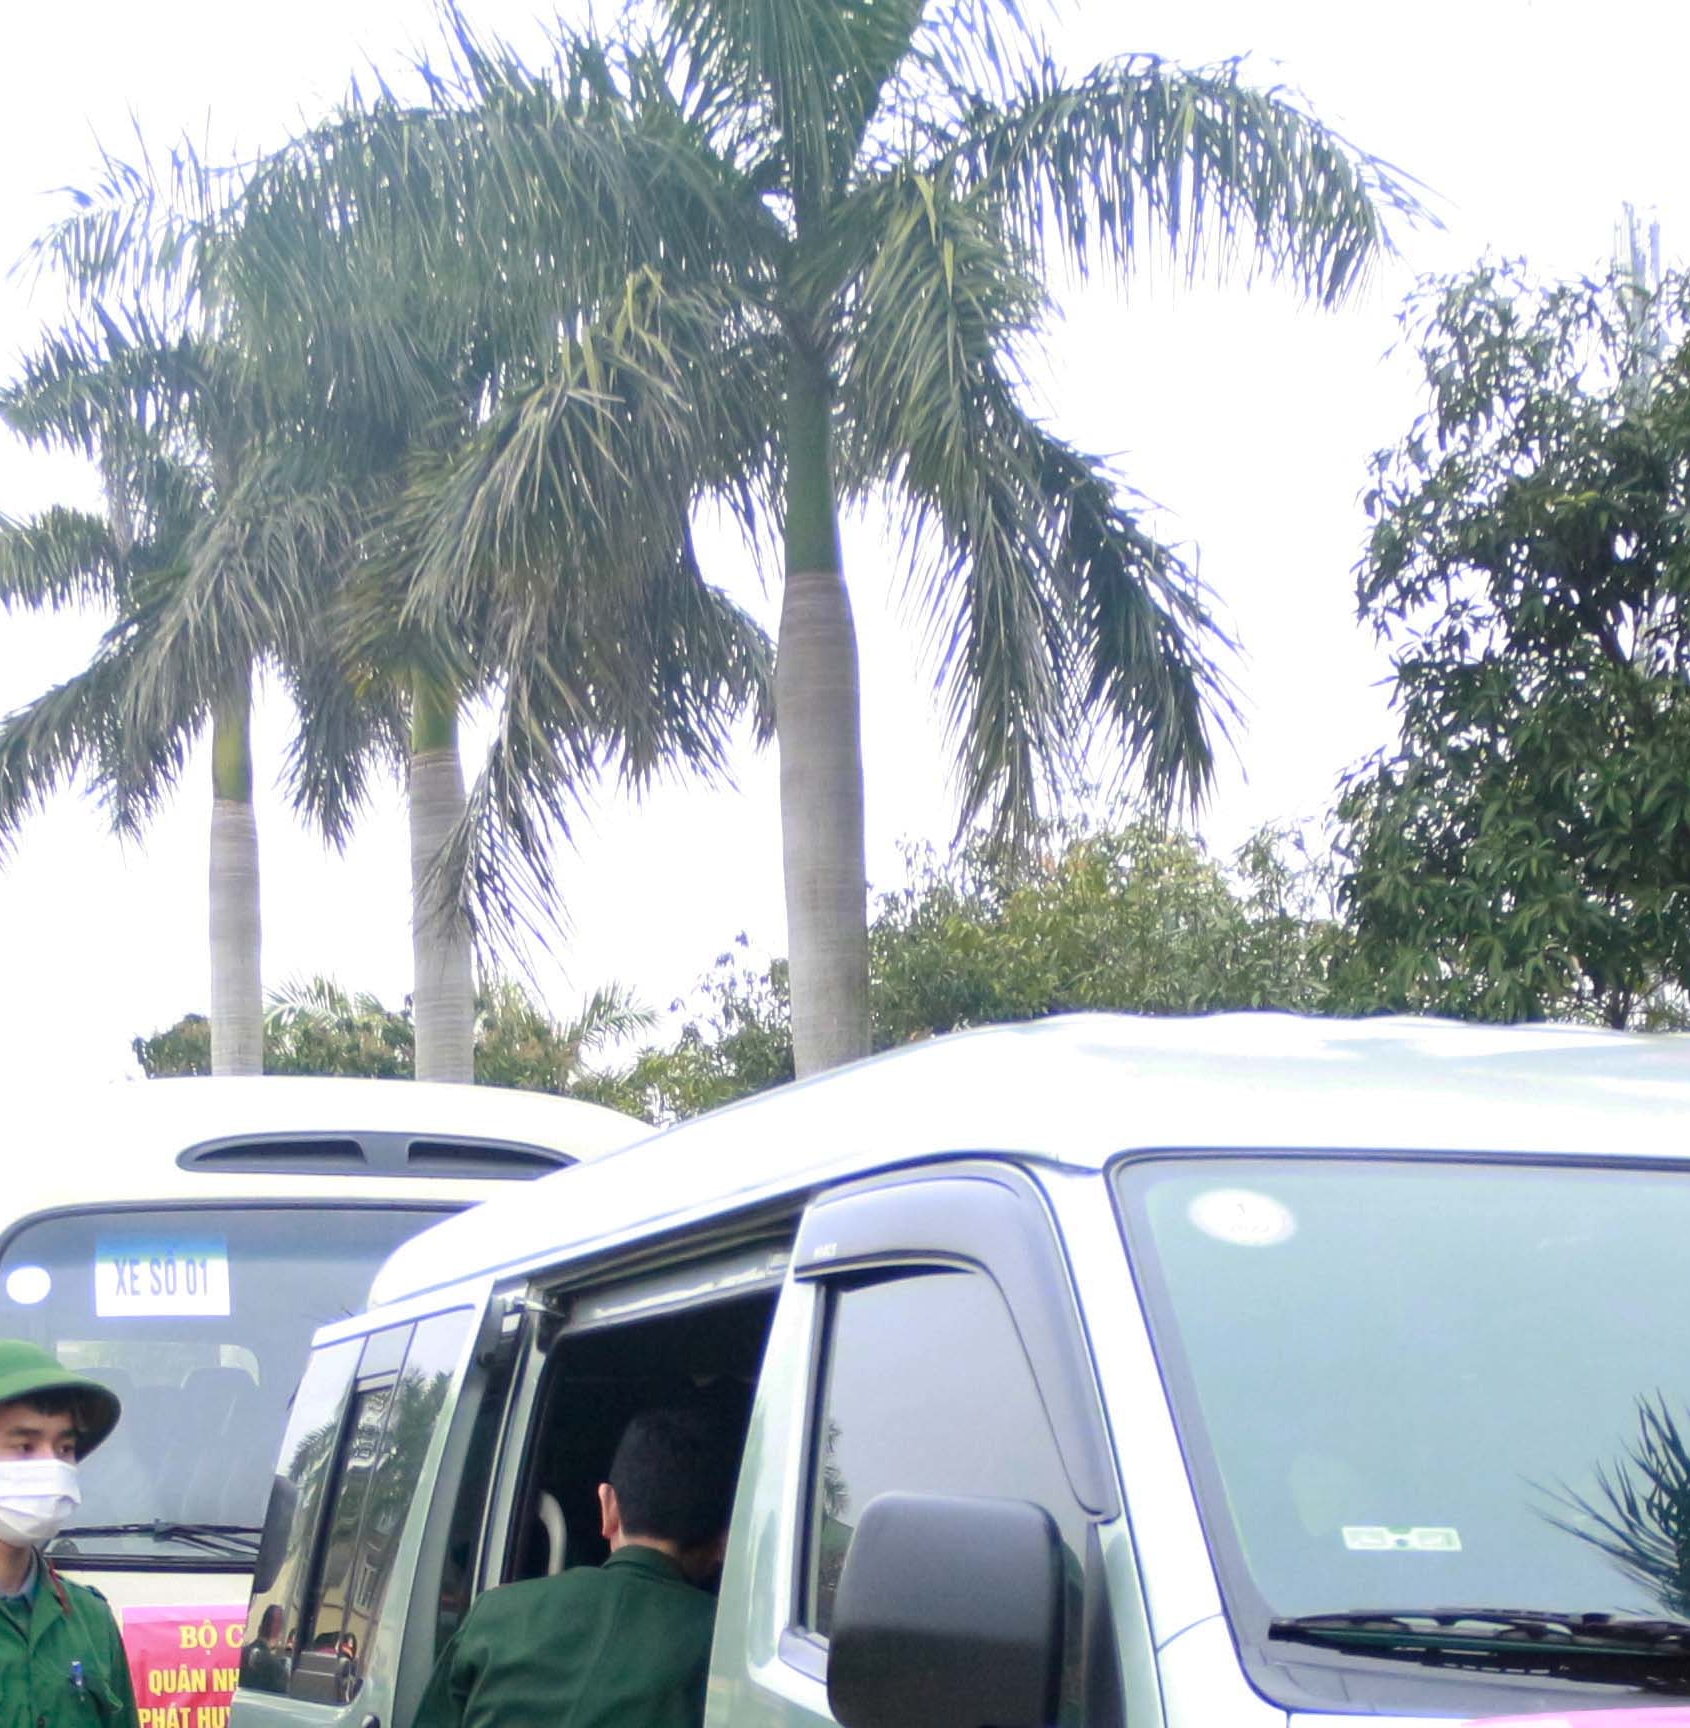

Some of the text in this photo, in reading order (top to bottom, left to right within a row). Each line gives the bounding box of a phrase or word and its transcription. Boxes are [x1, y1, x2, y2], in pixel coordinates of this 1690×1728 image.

[114, 1258, 141, 1296] XE
[186, 1258, 208, 1296] 01
[179, 1619, 245, 1655] BỘ C
[149, 1664, 240, 1696] QUÂN NH
